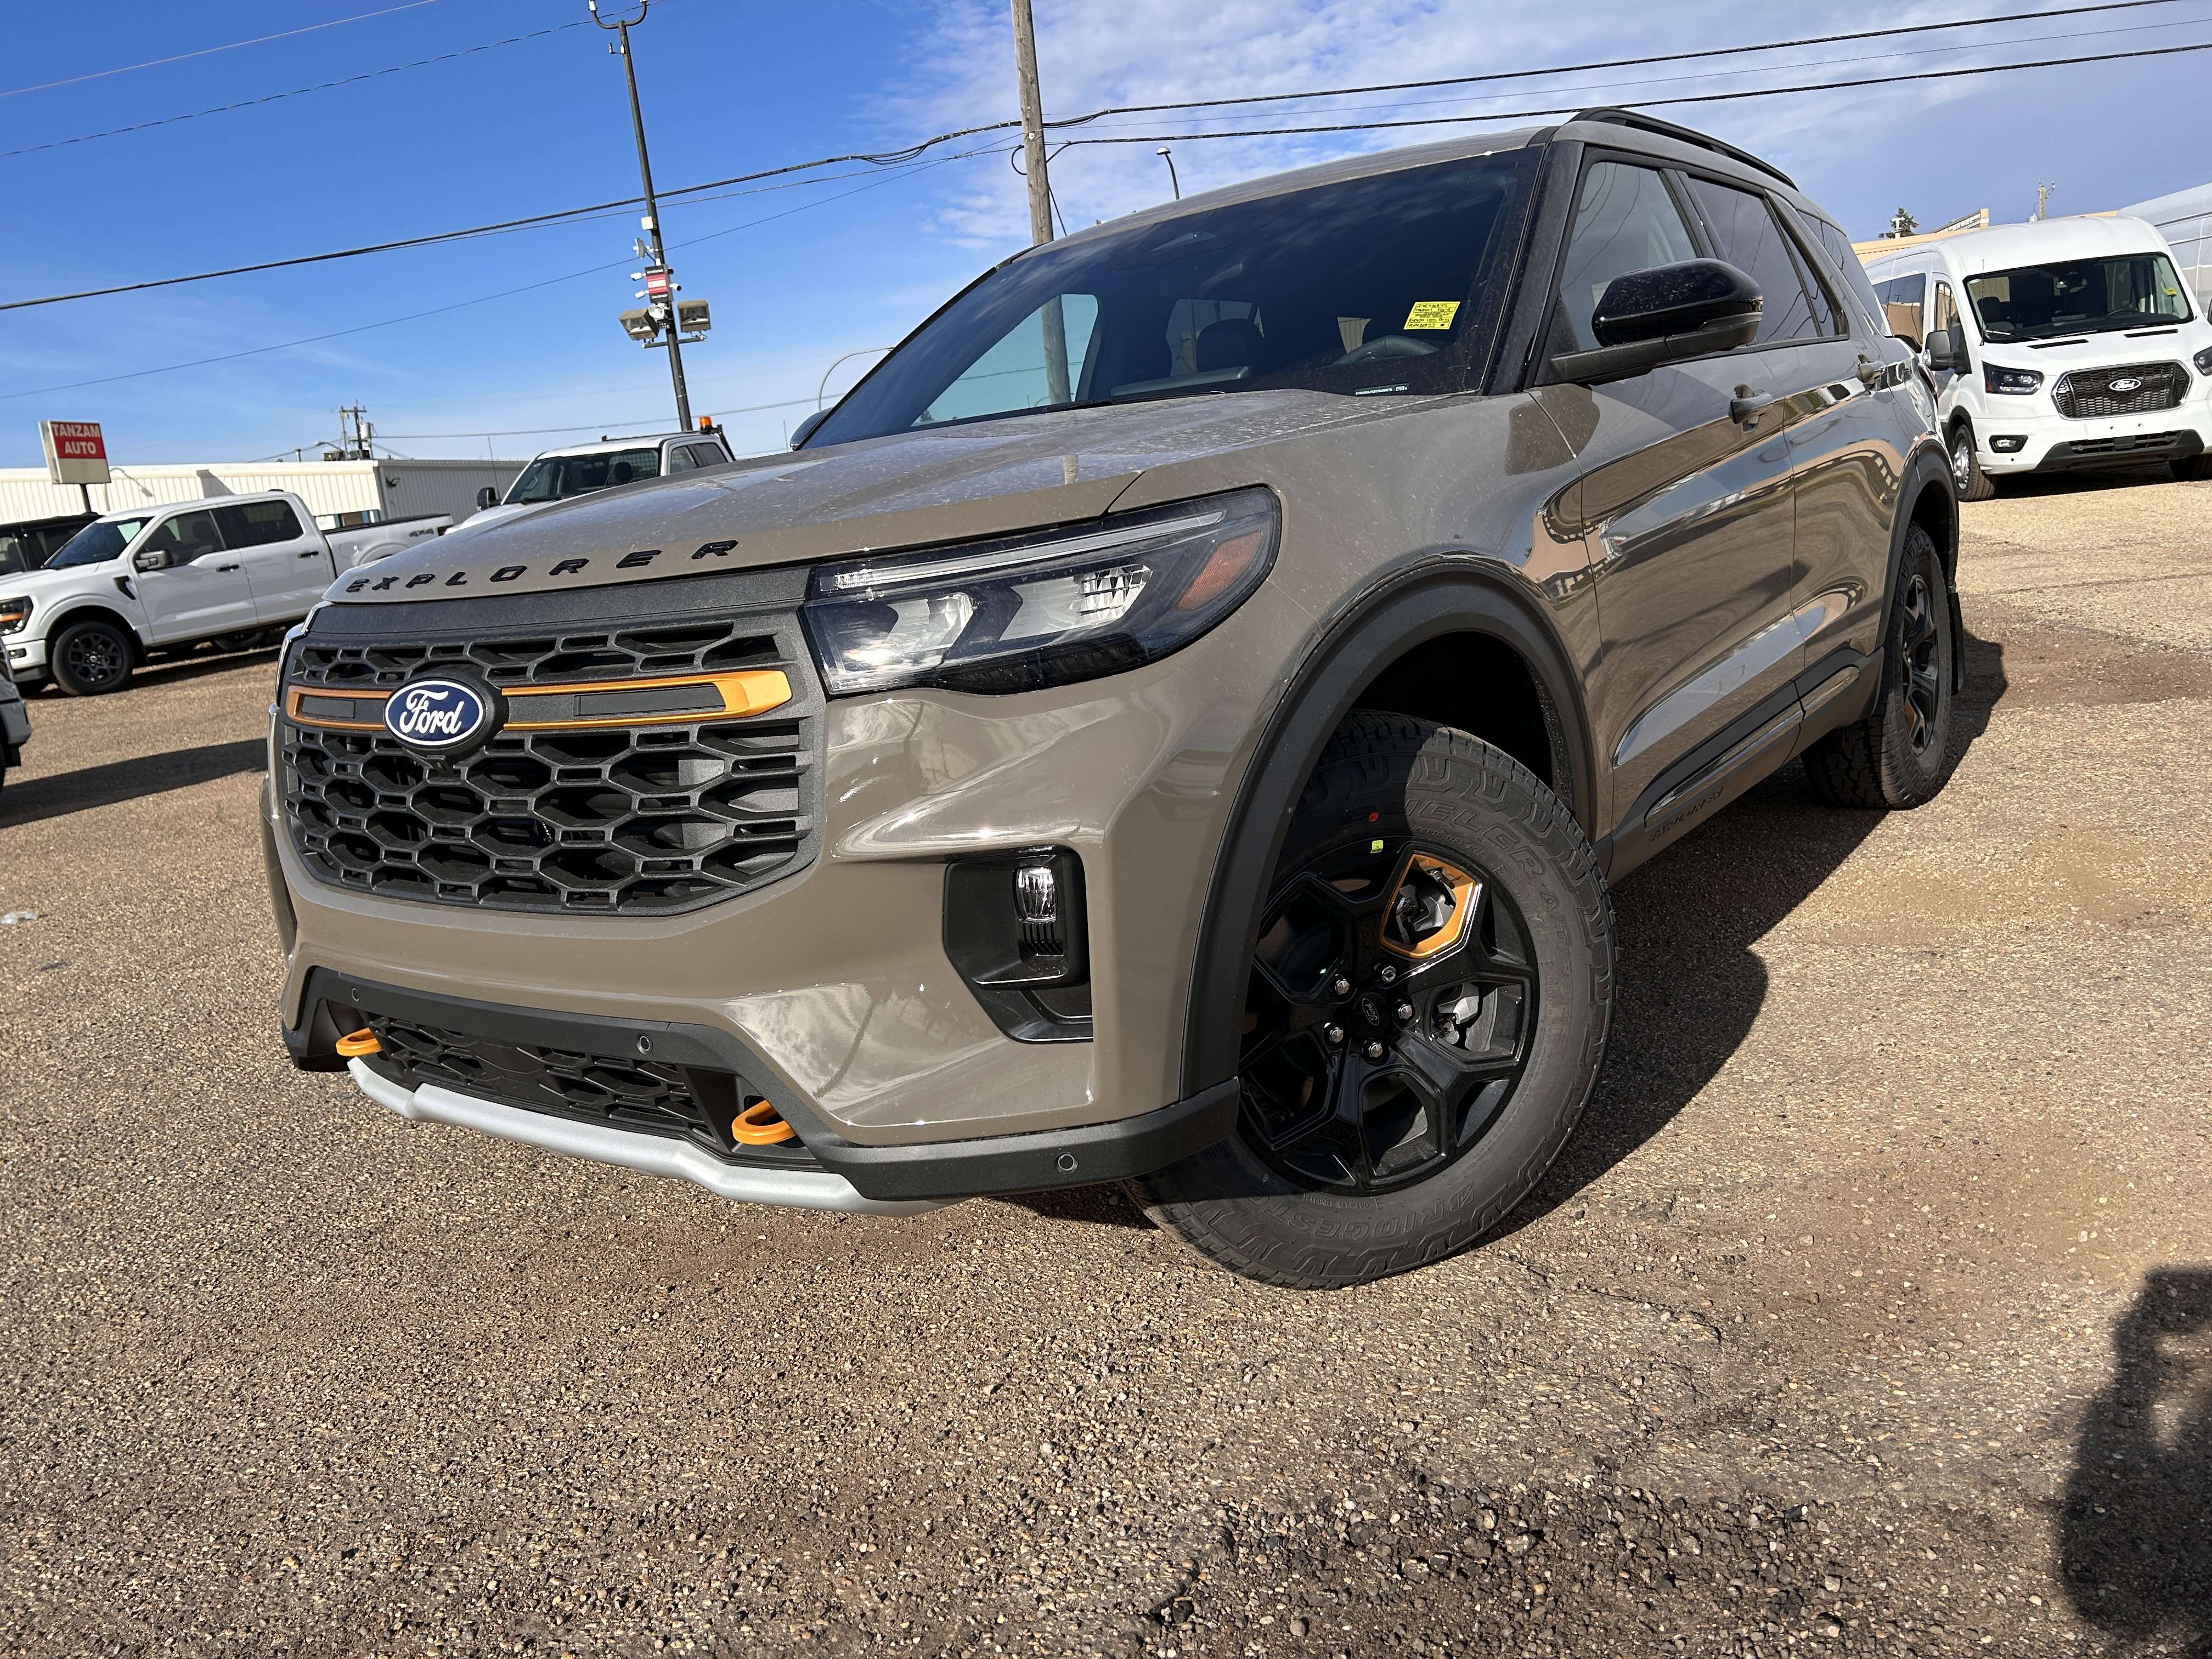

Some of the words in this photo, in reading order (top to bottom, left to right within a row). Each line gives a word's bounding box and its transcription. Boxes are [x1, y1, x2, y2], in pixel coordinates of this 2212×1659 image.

[2115, 380, 2135, 389] Ford
[52, 424, 100, 438] TANZAM
[65, 441, 97, 455] AUTO
[346, 539, 739, 593] EXPLORER
[399, 688, 465, 735] Ford
